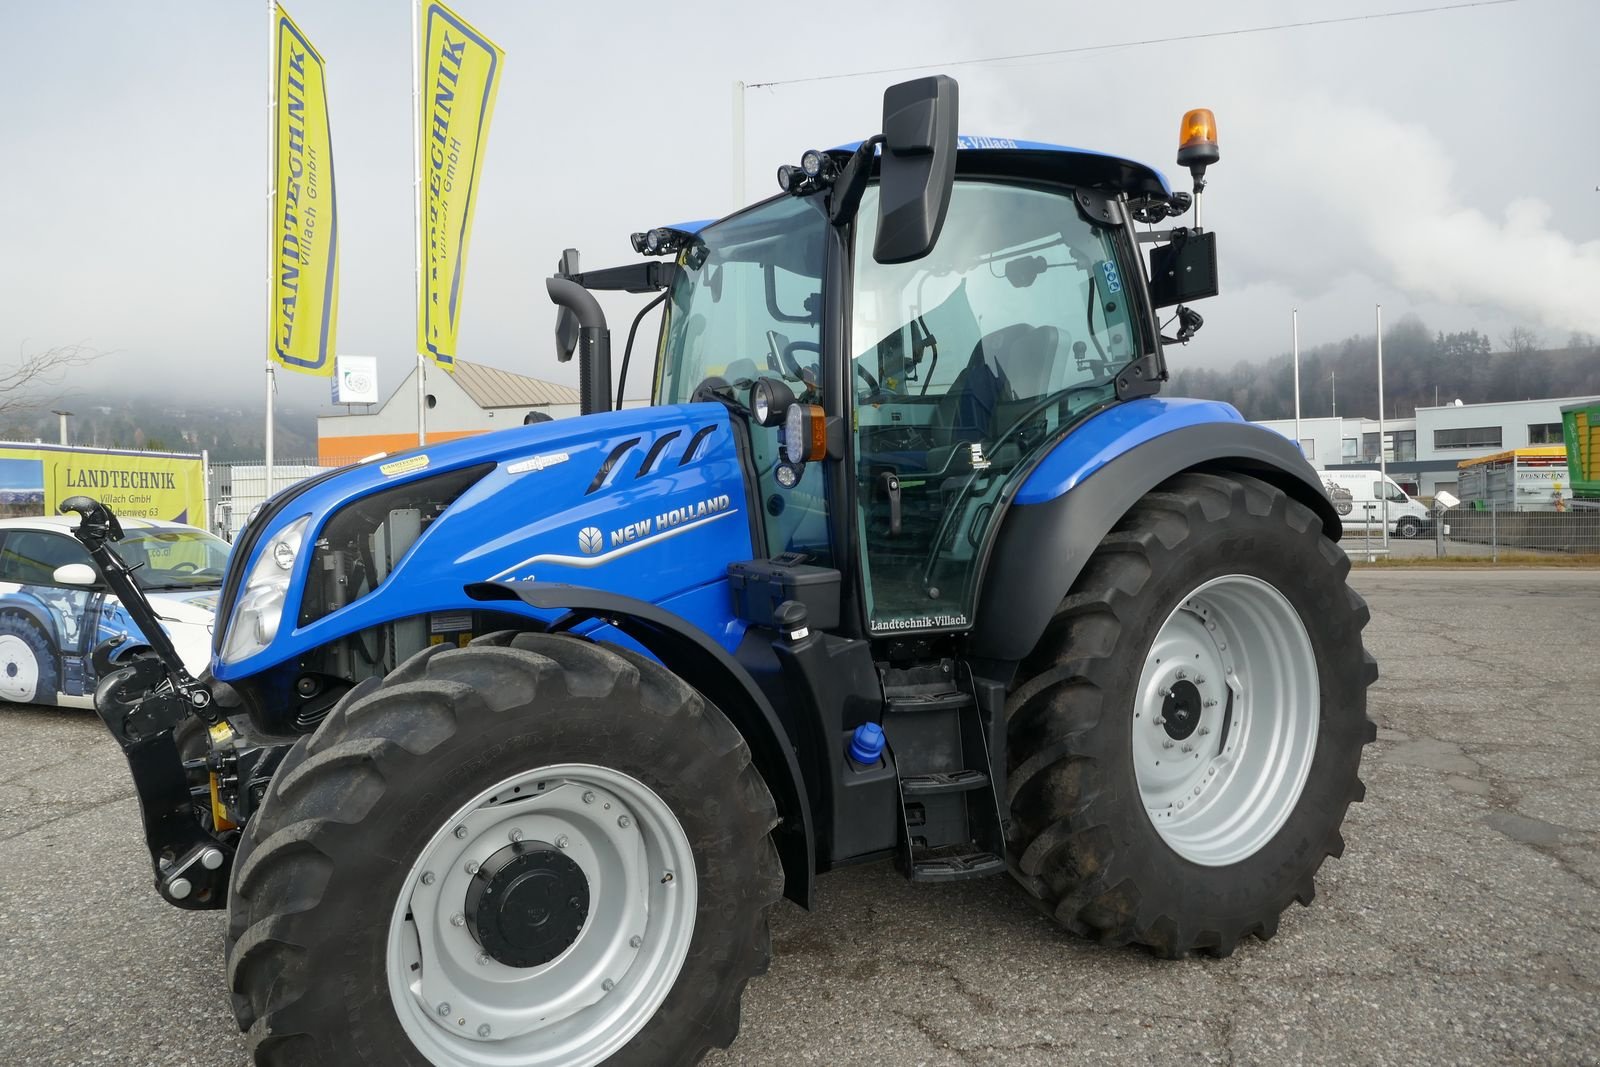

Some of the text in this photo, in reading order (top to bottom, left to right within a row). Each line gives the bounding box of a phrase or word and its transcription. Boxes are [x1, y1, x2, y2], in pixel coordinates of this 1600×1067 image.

[443, 136, 461, 193] GmbH
[280, 41, 305, 349] LANDTECHNIK
[300, 145, 318, 267] Villach GmbH
[66, 468, 176, 489] LANDTECHNIK
[100, 494, 152, 503] Villach GmbH
[149, 507, 159, 517] 63
[611, 494, 730, 547] NEW HOLLAND
[871, 614, 967, 631] Landtechnik-Villach
